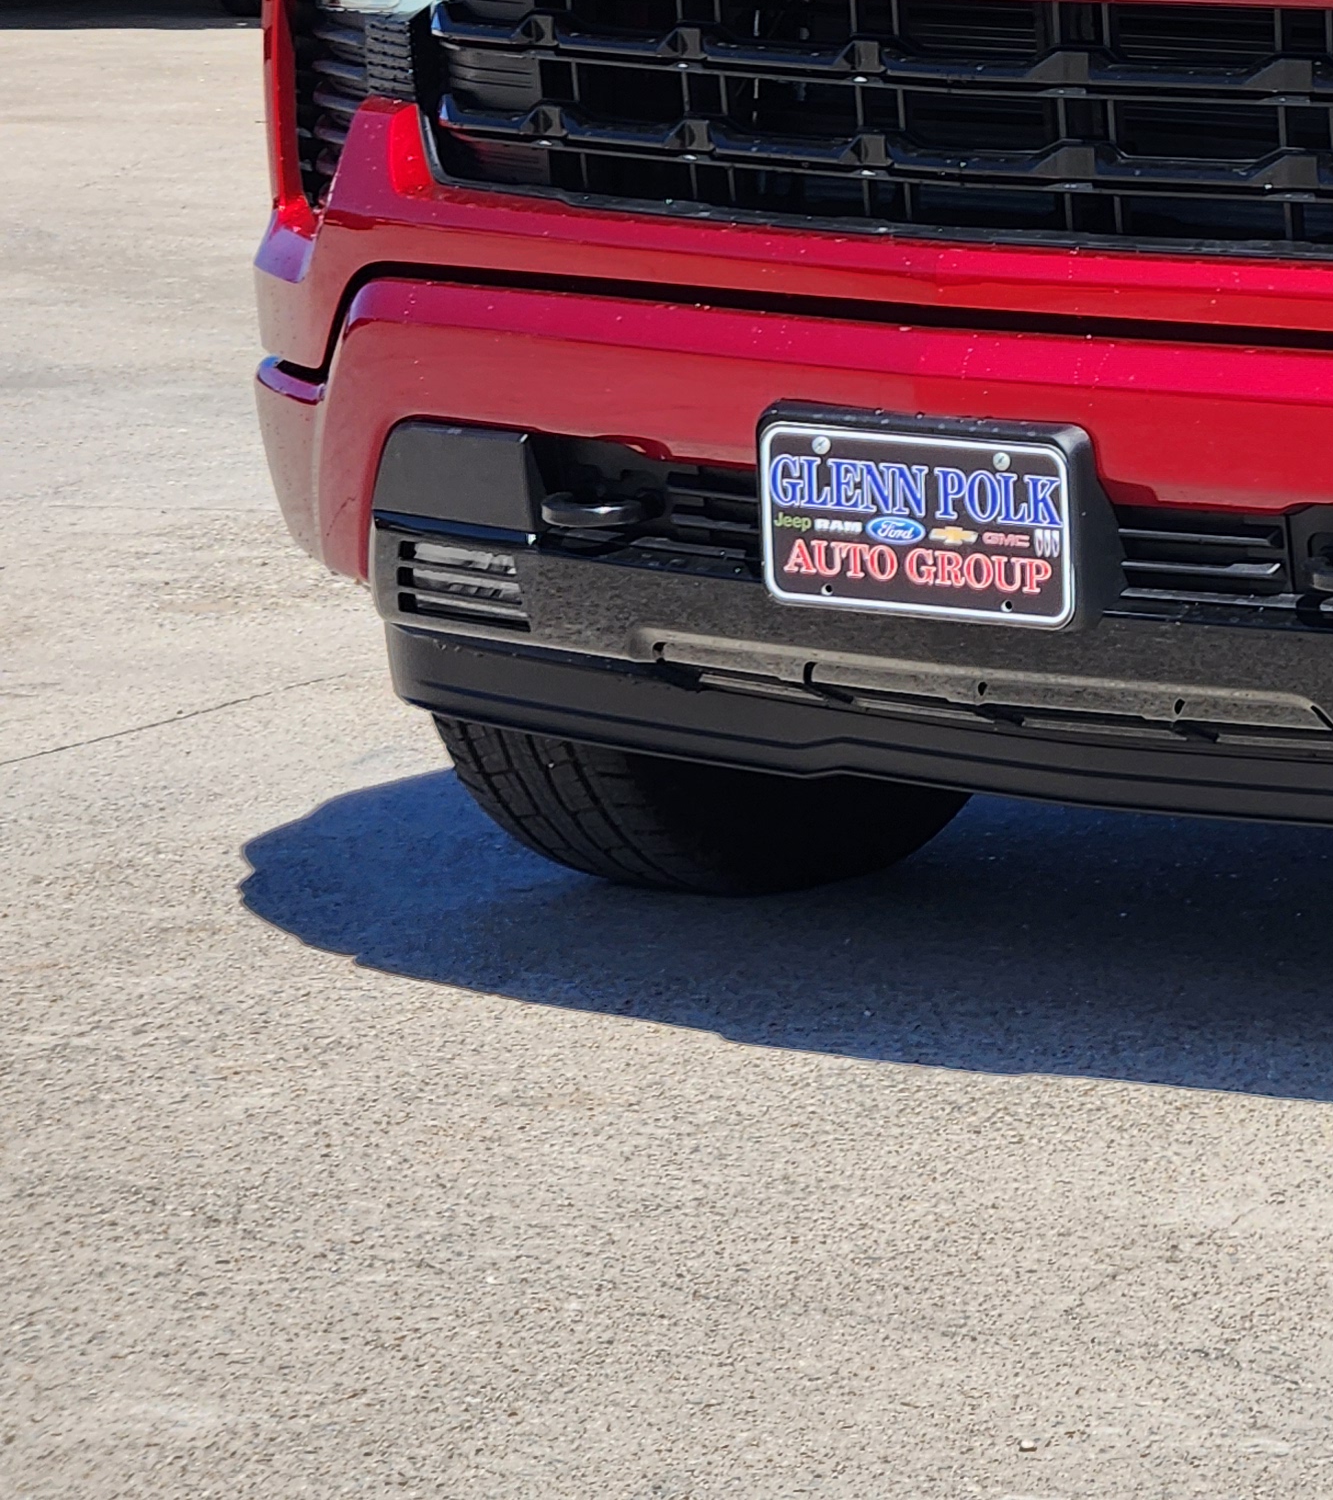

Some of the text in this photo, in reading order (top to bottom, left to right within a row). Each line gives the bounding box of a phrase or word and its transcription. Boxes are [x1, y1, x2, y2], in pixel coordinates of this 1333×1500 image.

[769, 453, 1063, 527] GLENN POLK
[773, 512, 1031, 548] Jeep RAM Ford GMC
[783, 538, 1052, 595] AUTO GROUP
